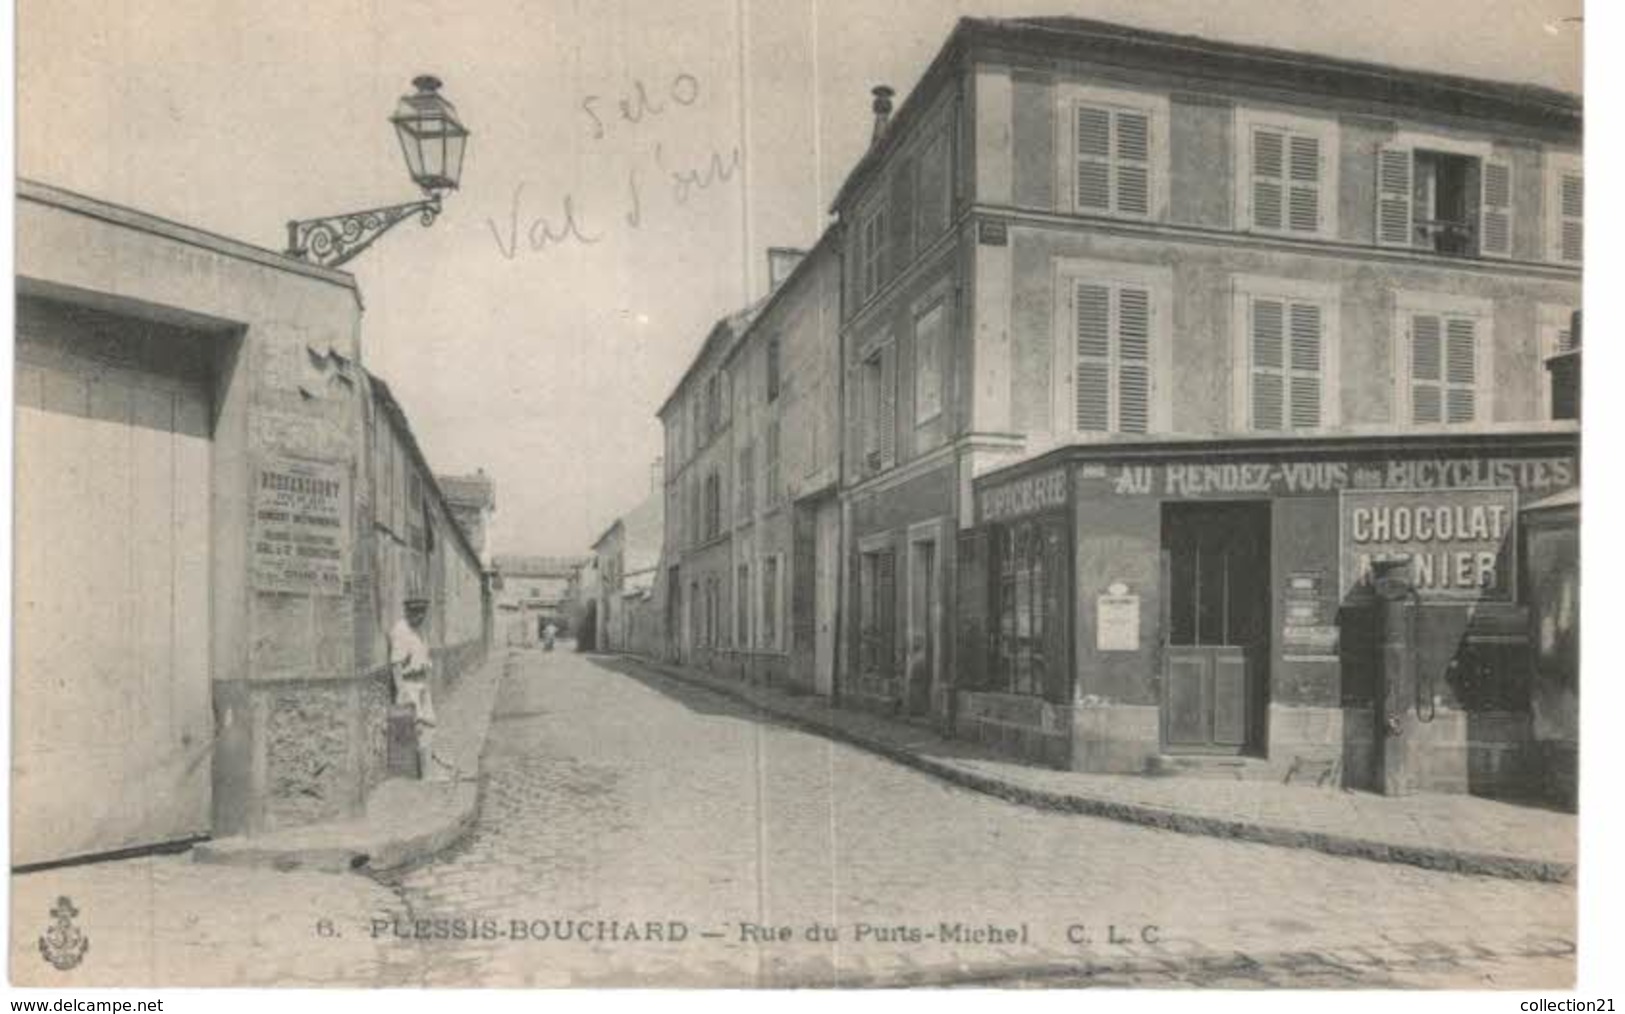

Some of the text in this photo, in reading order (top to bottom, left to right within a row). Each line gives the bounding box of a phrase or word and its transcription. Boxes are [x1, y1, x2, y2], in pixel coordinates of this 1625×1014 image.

[487, 180, 603, 259] Val
[1115, 465, 1150, 494] AU
[1166, 461, 1348, 497] RENDEZ-VOUS
[1387, 458, 1573, 488] BICYCLISTES
[1352, 505, 1505, 542] CHOCOLAT
[1357, 551, 1498, 588] MNIER
